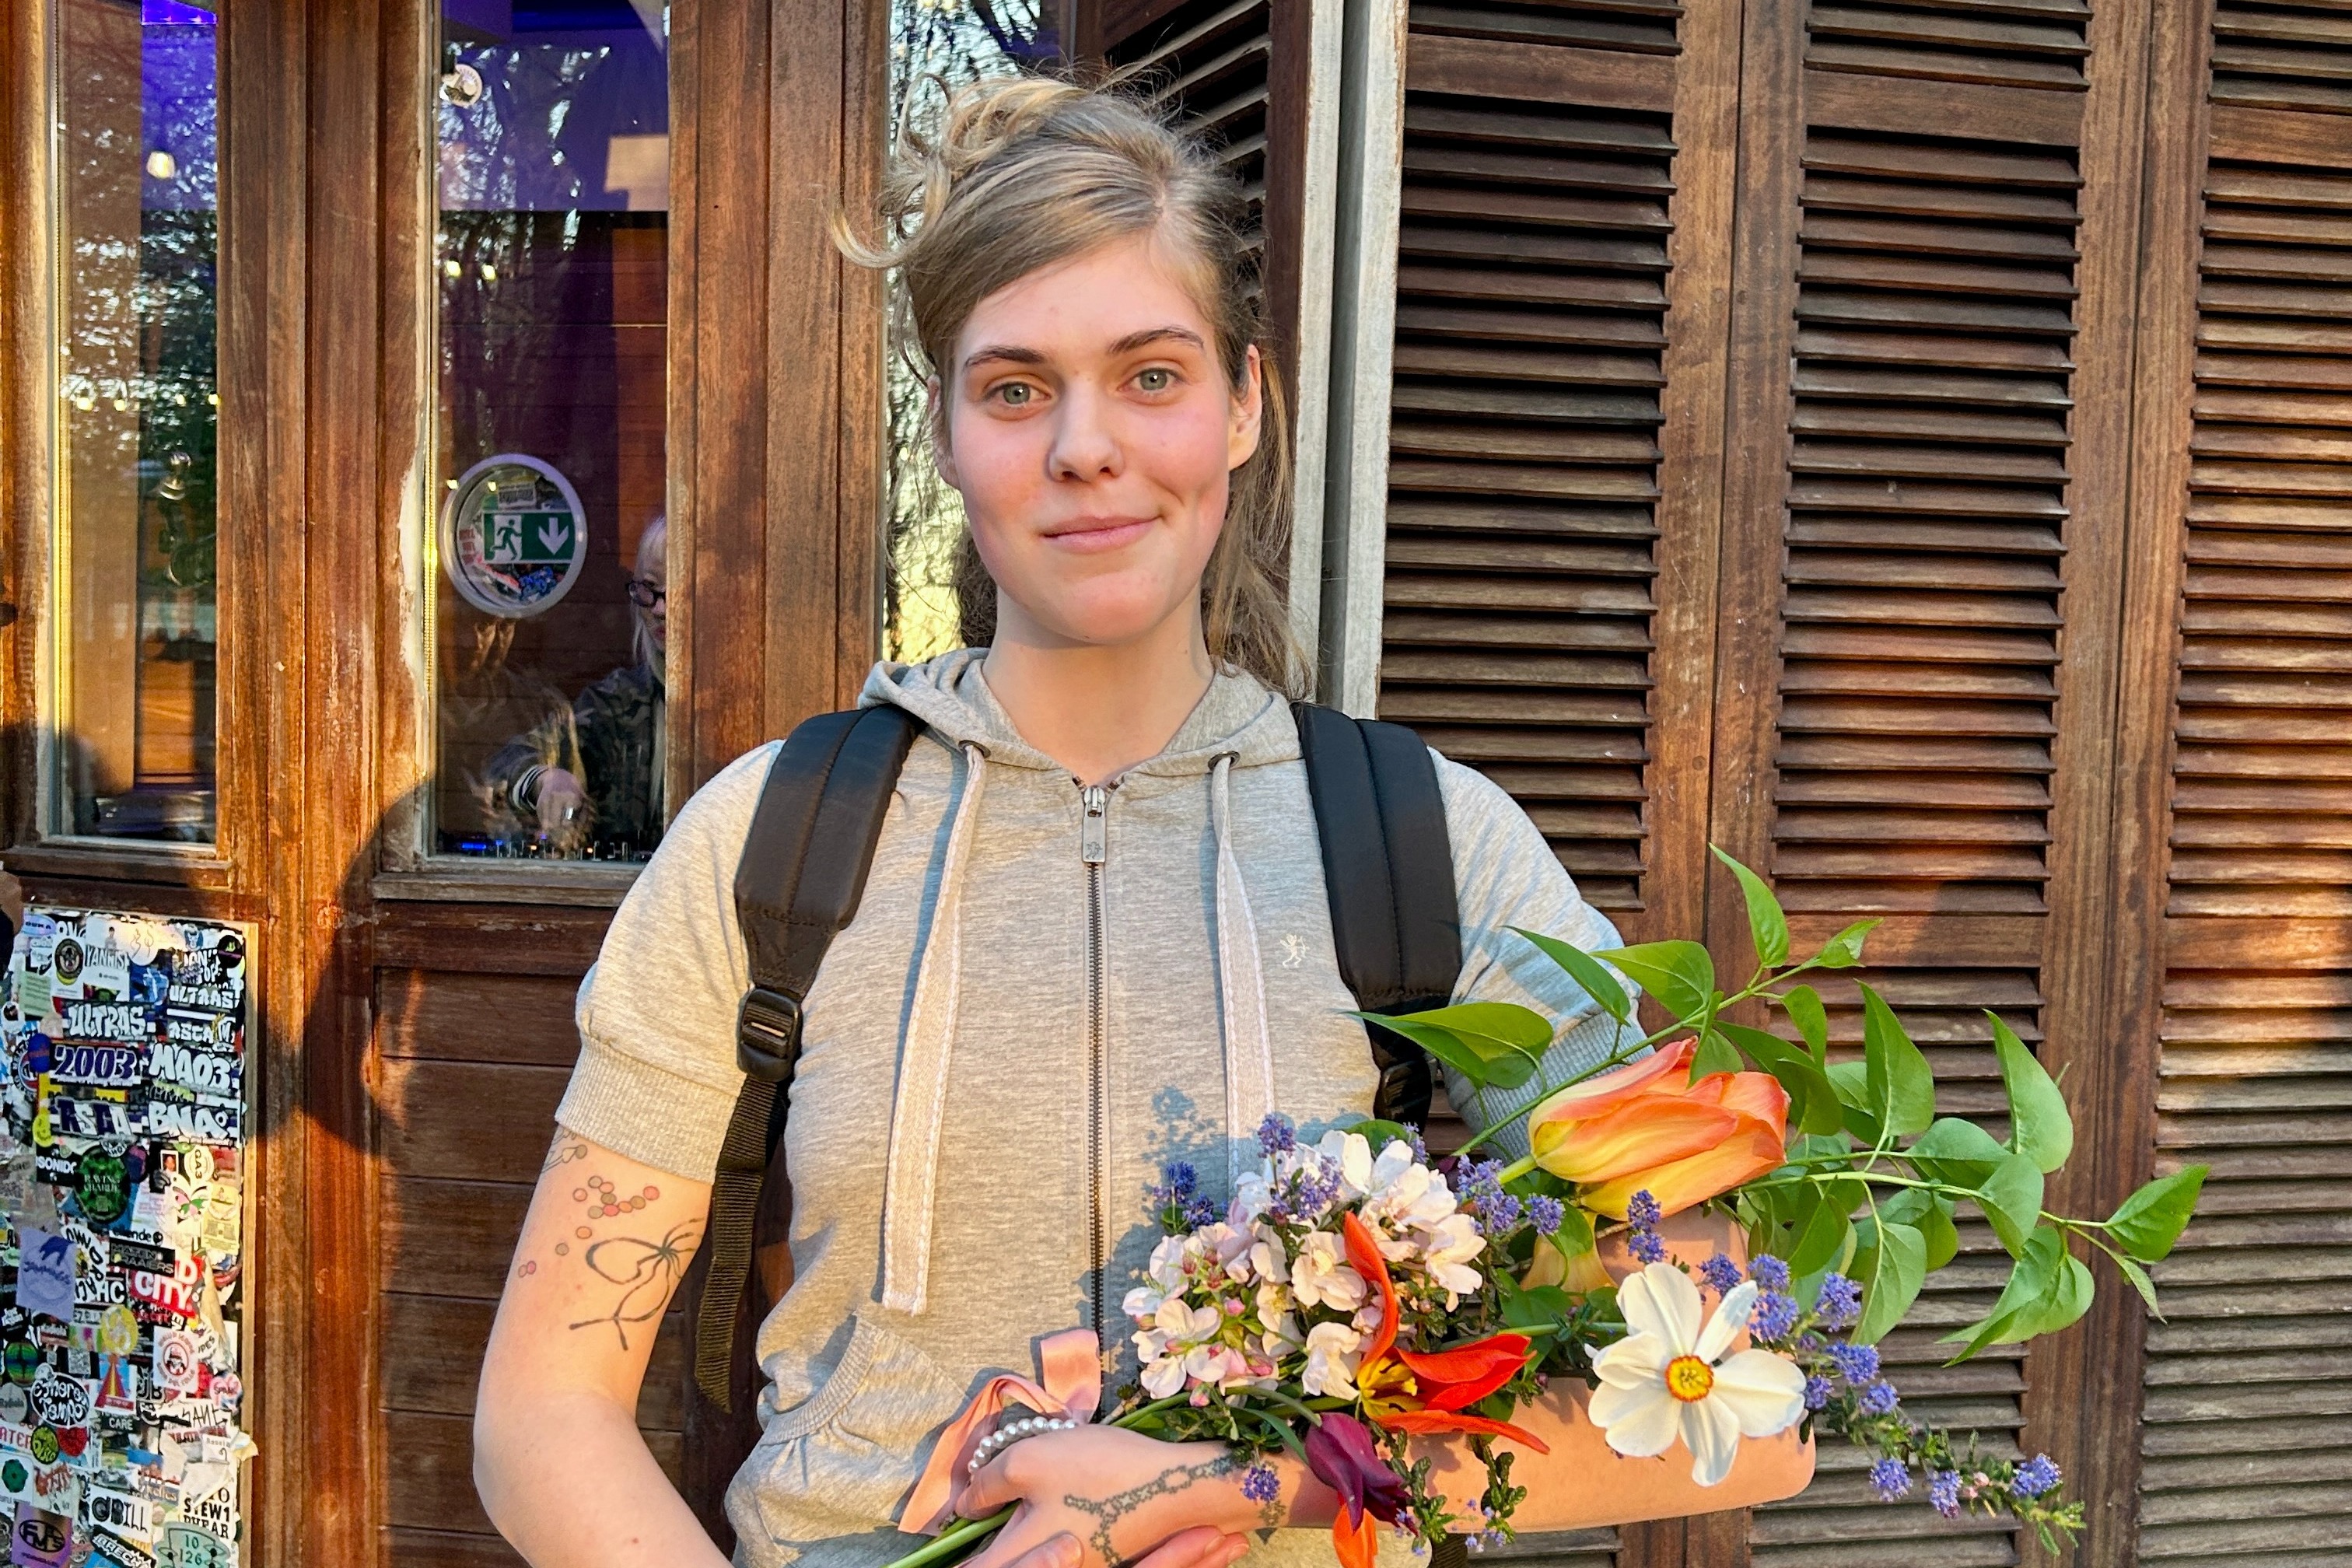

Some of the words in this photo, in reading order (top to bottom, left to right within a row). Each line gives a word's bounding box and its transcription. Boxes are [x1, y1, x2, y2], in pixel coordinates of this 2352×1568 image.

[68, 1003, 146, 1038] ULTRAS
[54, 1045, 138, 1080] 2003
[134, 1269, 193, 1311] CITY
[109, 1417, 134, 1431] CARE
